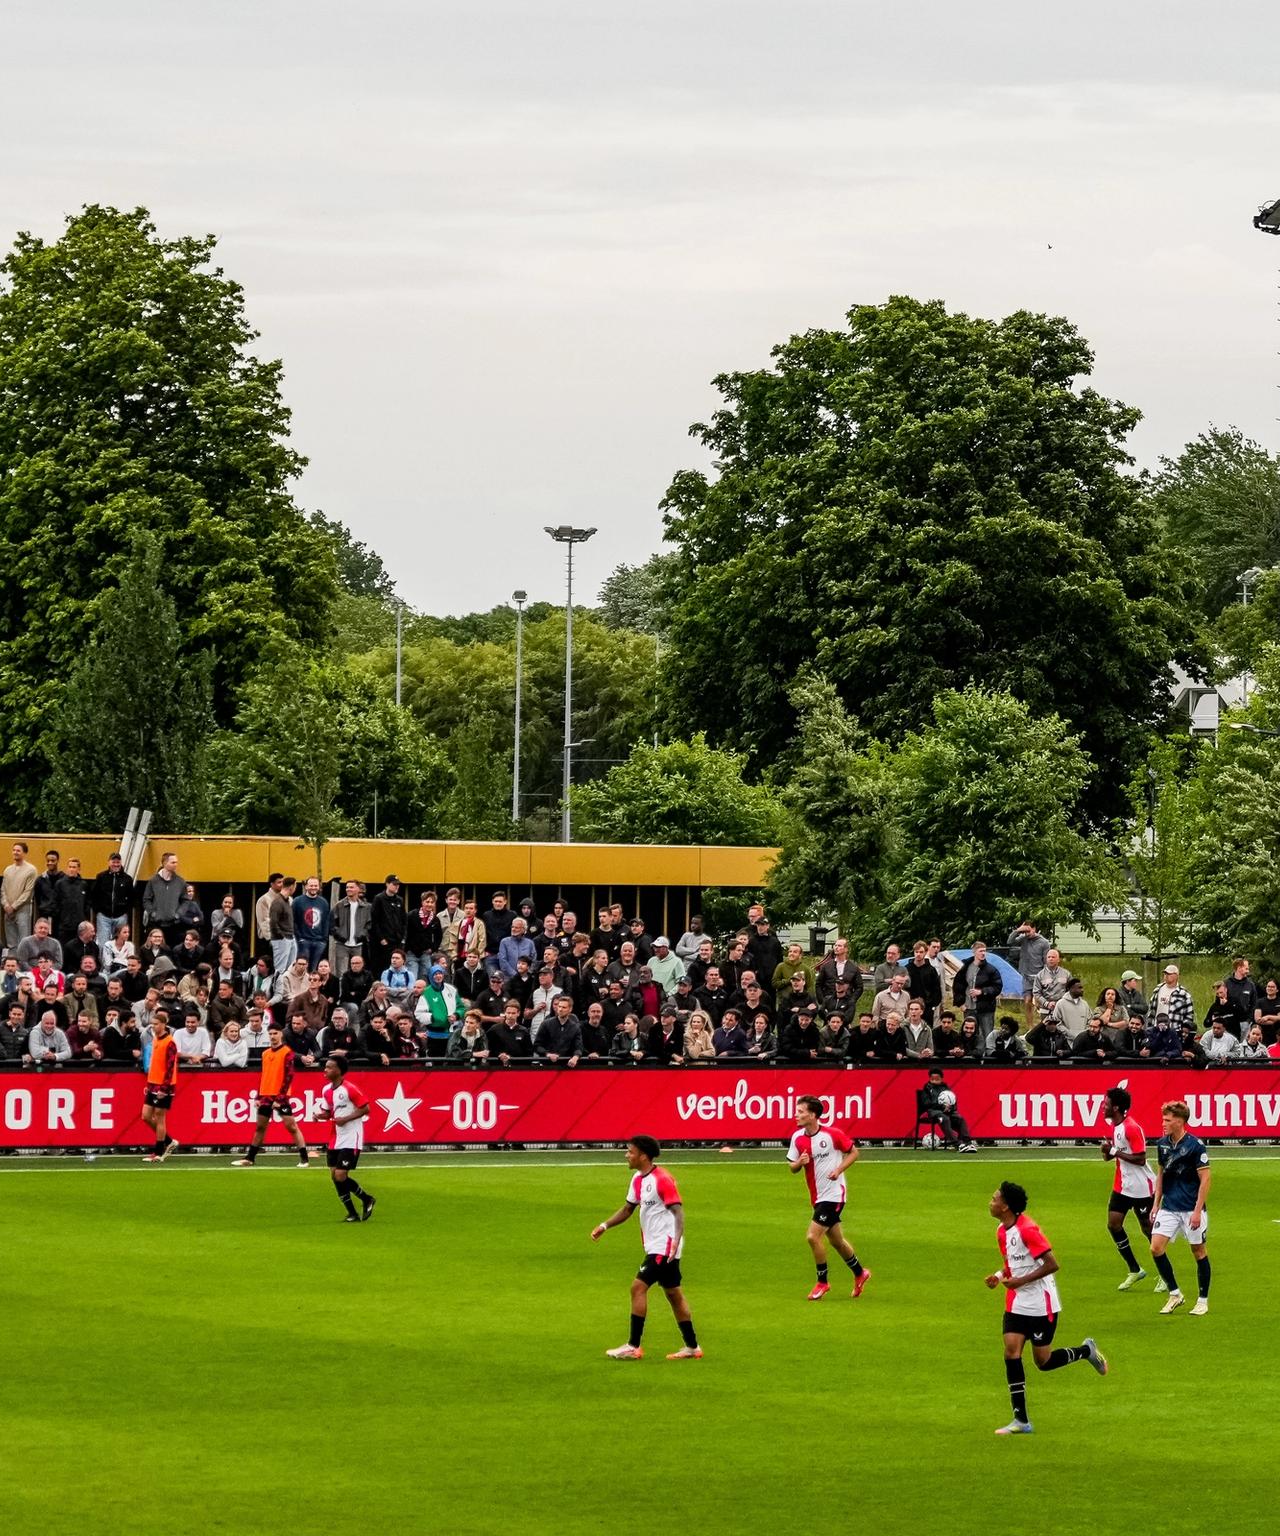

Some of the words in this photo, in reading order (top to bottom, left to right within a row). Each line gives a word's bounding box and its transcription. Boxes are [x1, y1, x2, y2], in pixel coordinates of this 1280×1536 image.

[200, 1089, 370, 1124] Heiek
[676, 1078, 872, 1127] verlonig.nl
[999, 1079, 1128, 1127] univ
